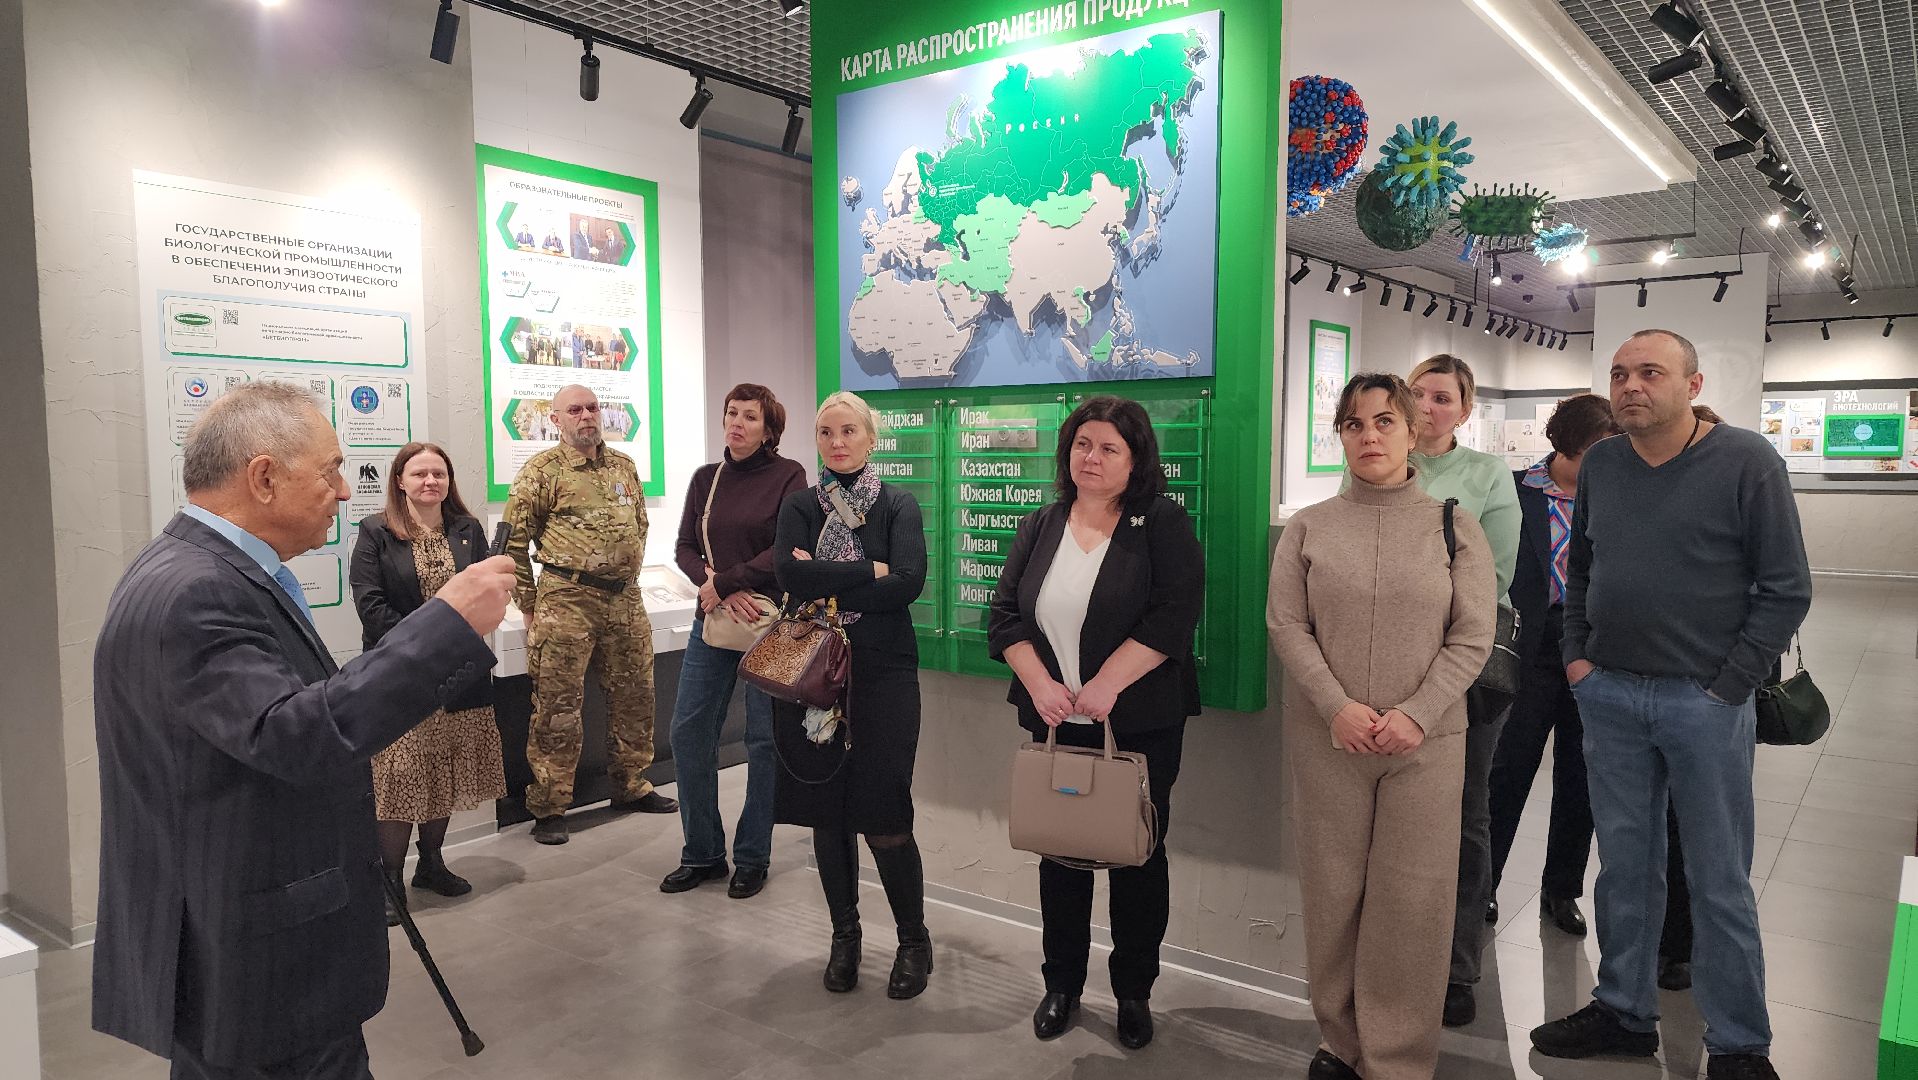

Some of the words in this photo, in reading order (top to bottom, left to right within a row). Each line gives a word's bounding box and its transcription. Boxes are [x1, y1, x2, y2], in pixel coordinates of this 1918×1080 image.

[840, 47, 892, 82] КАРТА
[897, 1, 1077, 69] РАСПРОСТРАНЕНИЯ
[509, 181, 587, 202] ОБРАЗОВАТЕЛЬНЫЕ
[588, 196, 623, 209] ПРОЕКТЫ
[175, 223, 305, 248] ГОСУДАРСТВЕННЫЕ
[307, 240, 393, 260] ОРГАНИЗАЦИИ
[164, 237, 280, 260] БИОЛОГИЧЕСКОЙ
[284, 252, 402, 275] ПРОМЫШЛЕННОСТИ
[171, 254, 180, 264] В
[184, 256, 280, 275] ОБЕСПЕЧЕНИИ
[283, 267, 398, 288] ЭПИЗООТИЧЕСКОГО
[213, 274, 315, 294] БЛАГОПОЛУЧИЯ
[318, 286, 366, 299] СТРАНЫ
[1833, 390, 1858, 402] ЭРА
[879, 410, 924, 430] айджан
[960, 407, 989, 429] Ирак
[961, 431, 990, 452] Иран
[961, 458, 1021, 477] Казахстан
[960, 483, 1002, 502] Южная
[1005, 484, 1042, 506] Корея
[961, 508, 1024, 530] Кыргызст
[961, 533, 998, 552] Ливан
[960, 558, 1005, 581] Марокк
